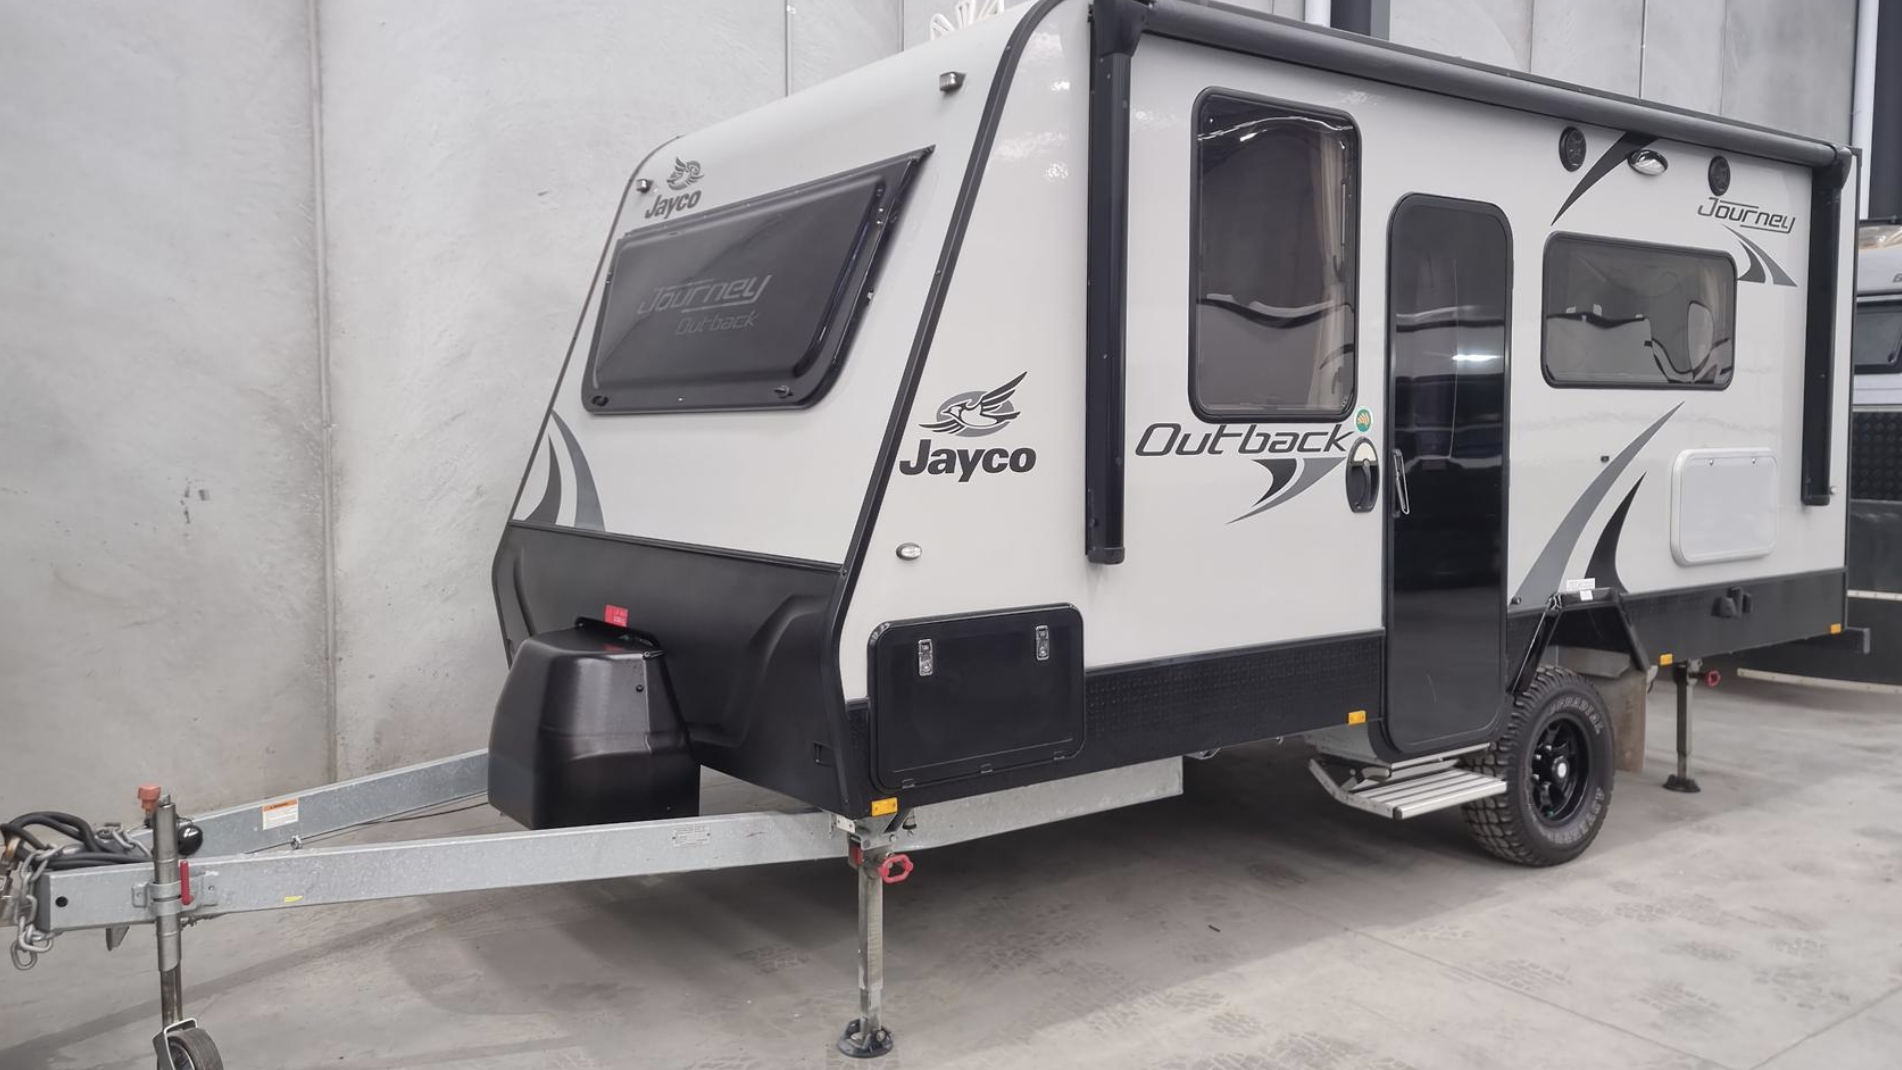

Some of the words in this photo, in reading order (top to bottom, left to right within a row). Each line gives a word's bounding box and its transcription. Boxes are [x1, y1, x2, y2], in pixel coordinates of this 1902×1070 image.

[645, 190, 701, 219] Jayco
[1697, 197, 1796, 234] Journey
[637, 275, 772, 314] Journey
[676, 310, 759, 335] Outback
[1136, 423, 1354, 456] Outback
[899, 439, 1036, 483] Jayco
